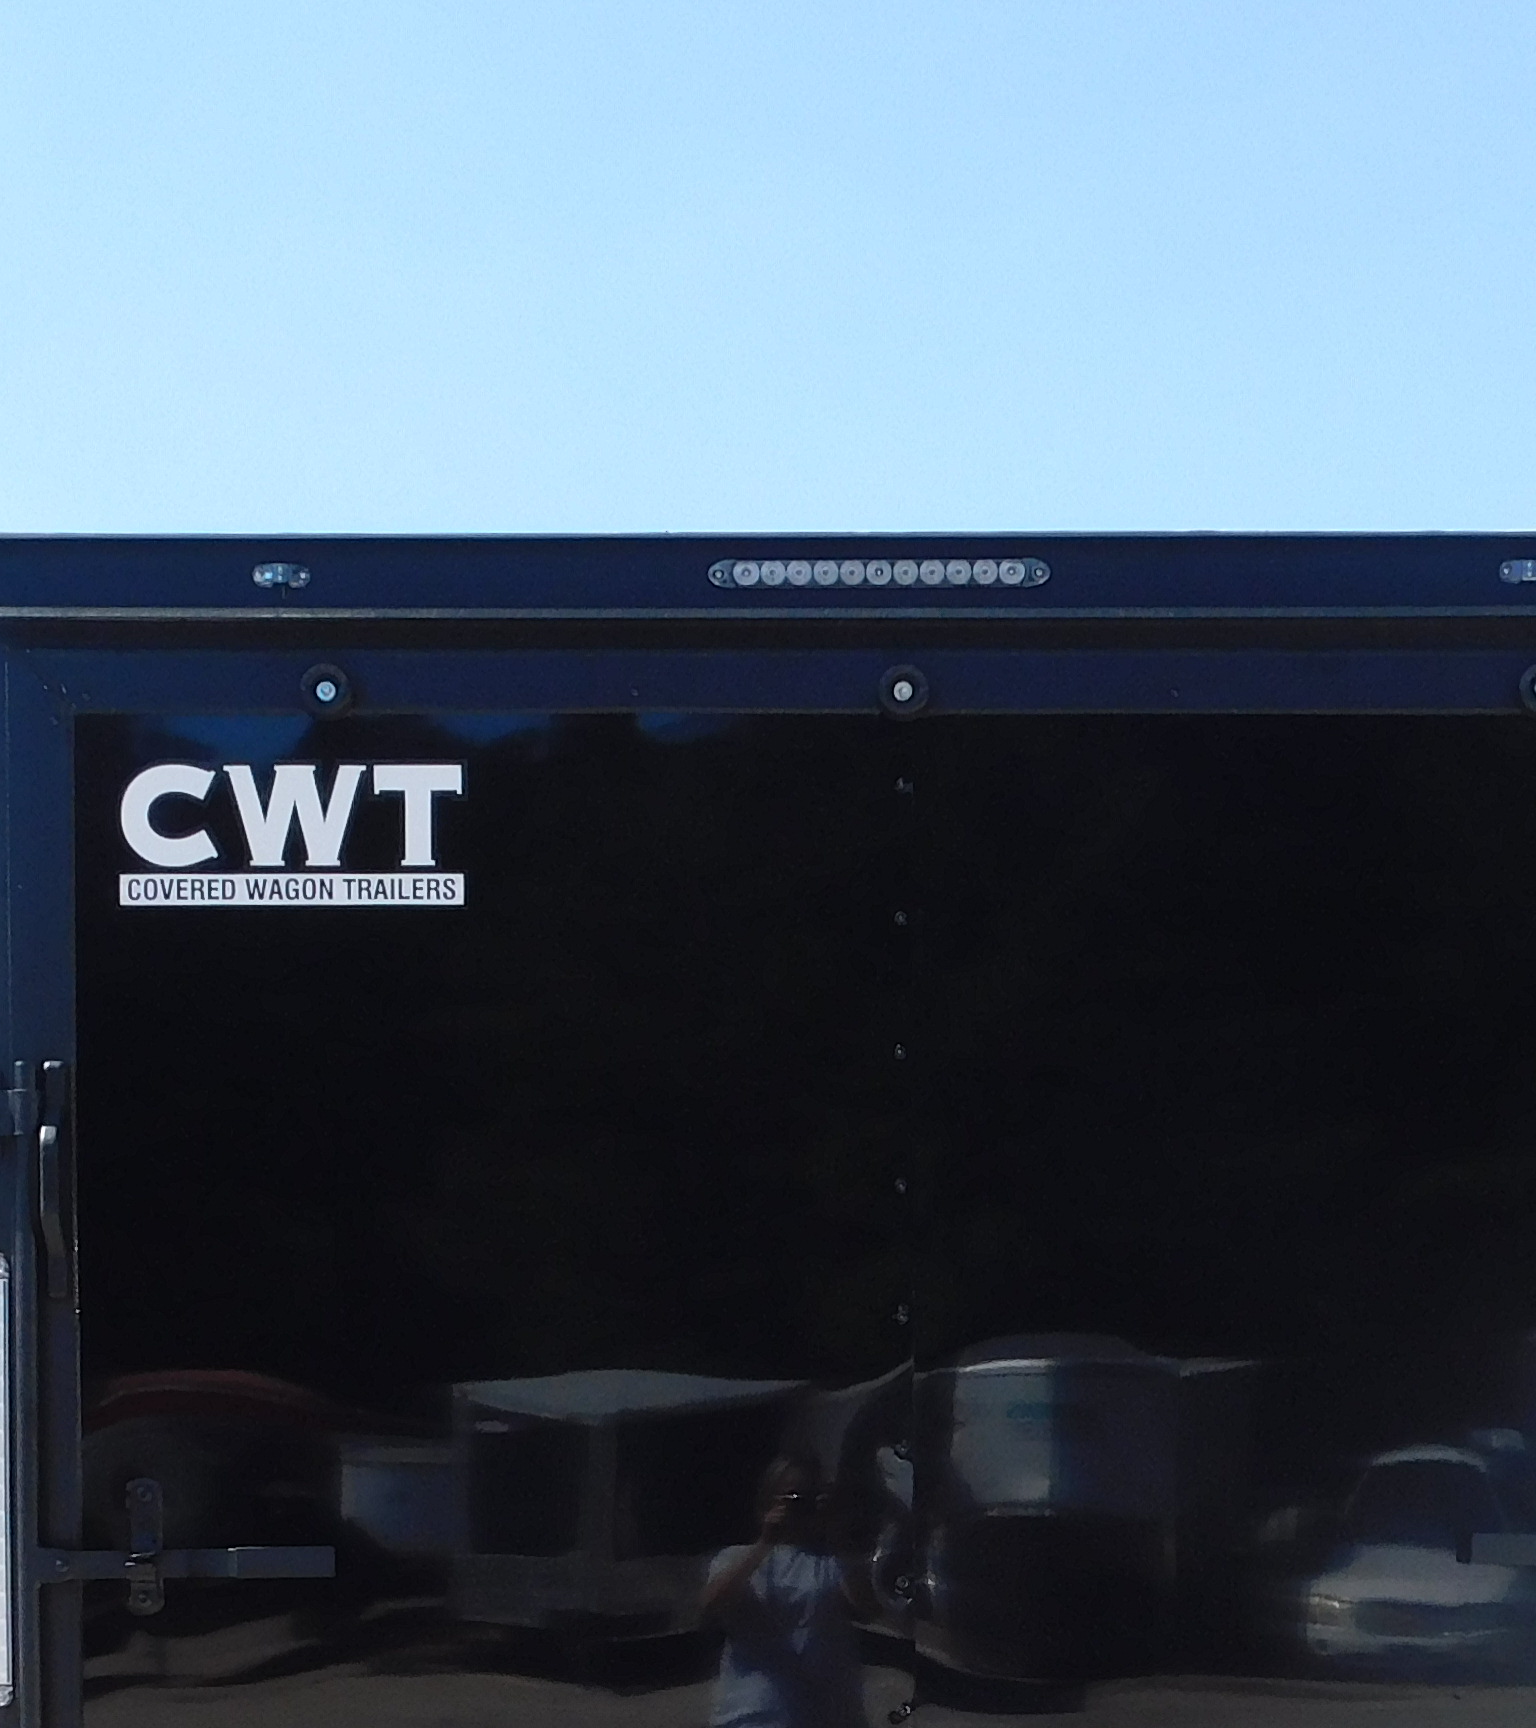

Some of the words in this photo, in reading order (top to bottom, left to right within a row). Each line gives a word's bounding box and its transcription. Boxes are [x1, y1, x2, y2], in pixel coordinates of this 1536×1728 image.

[120, 764, 463, 867] CWT
[127, 878, 236, 901] COVERED
[245, 878, 334, 901] WAGON
[342, 878, 456, 900] TRAILERS
